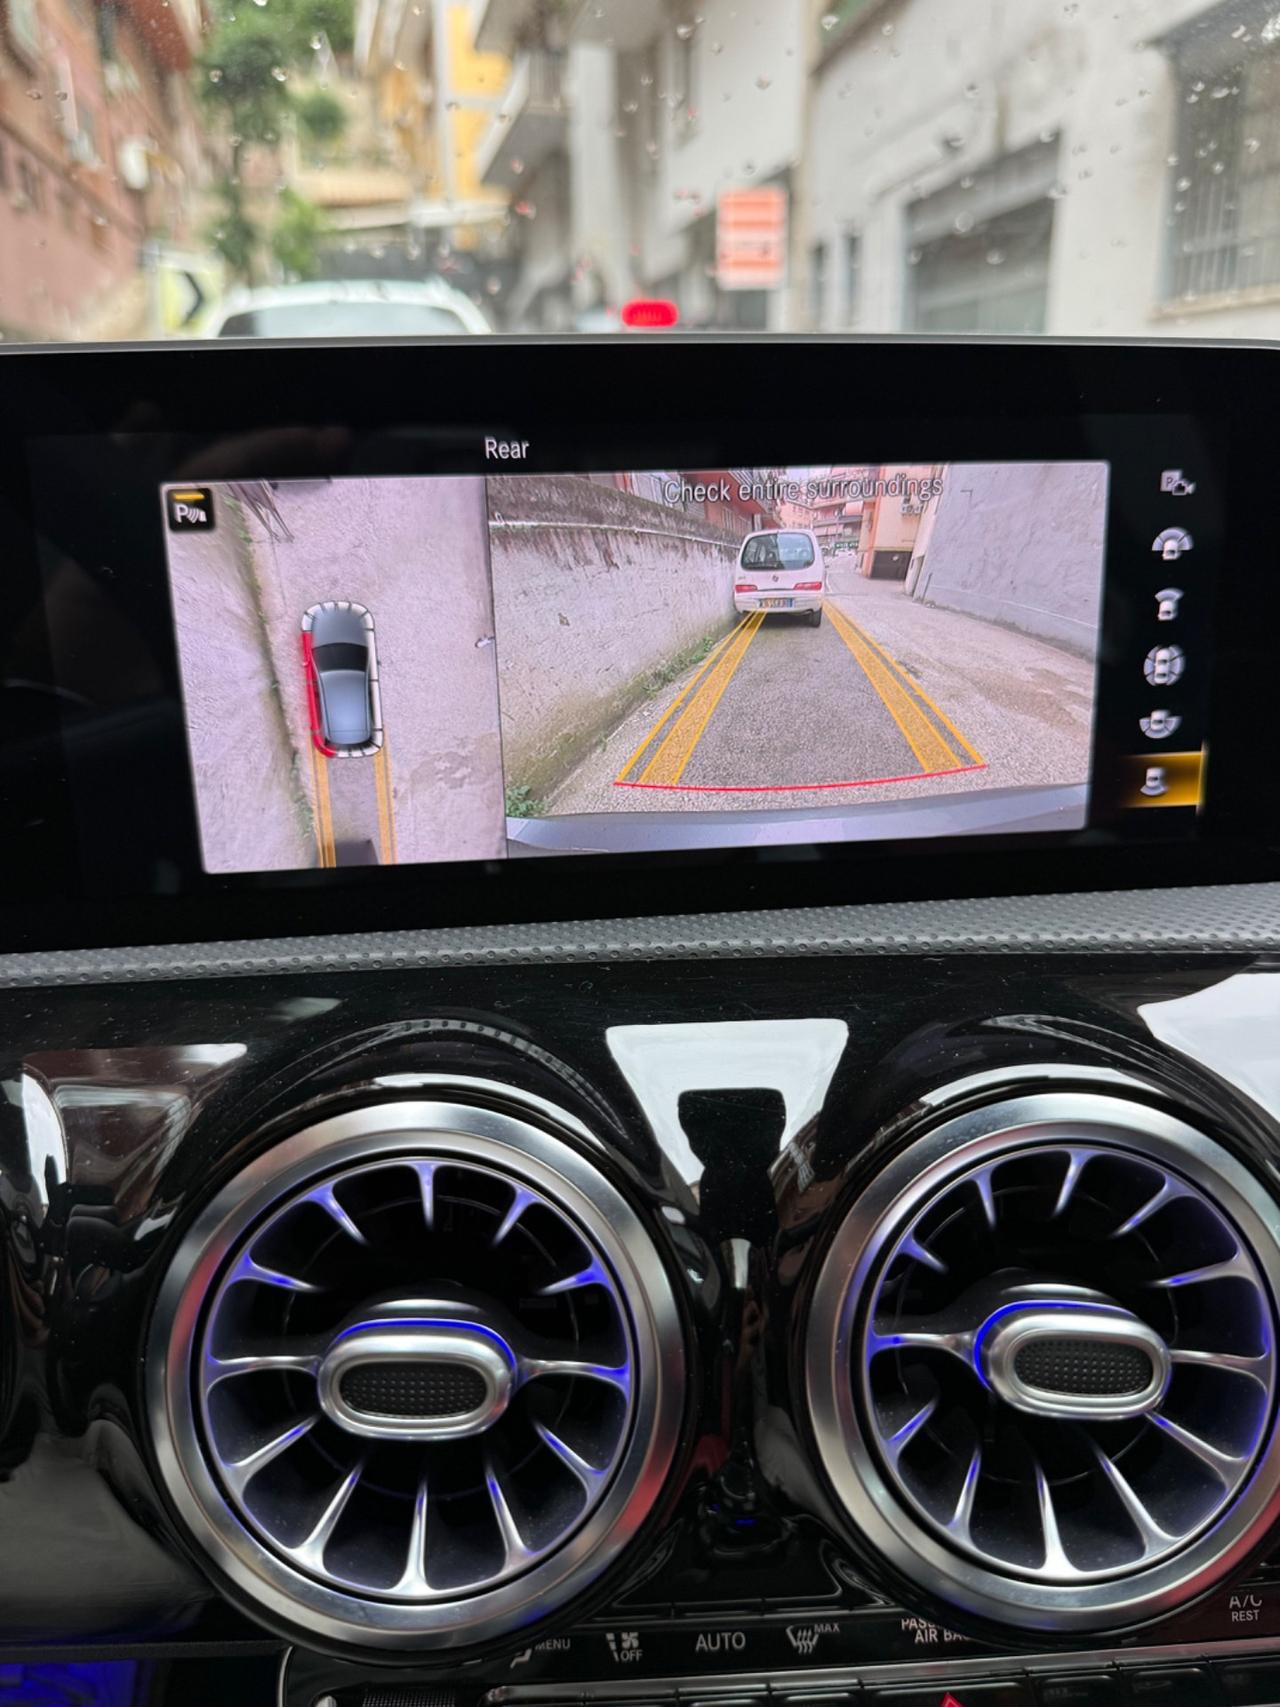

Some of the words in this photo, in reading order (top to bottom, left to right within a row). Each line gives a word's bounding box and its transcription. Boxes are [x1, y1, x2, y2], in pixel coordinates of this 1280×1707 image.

[485, 436, 530, 459] Rear
[664, 479, 731, 503] Check
[740, 476, 800, 501] entire
[806, 473, 944, 501] surroundings
[1231, 1609, 1260, 1622] REST
[813, 1622, 841, 1634] MAX
[914, 1628, 939, 1644] AIR
[695, 1631, 747, 1652] AUTO
[620, 1649, 644, 1662] OFF
